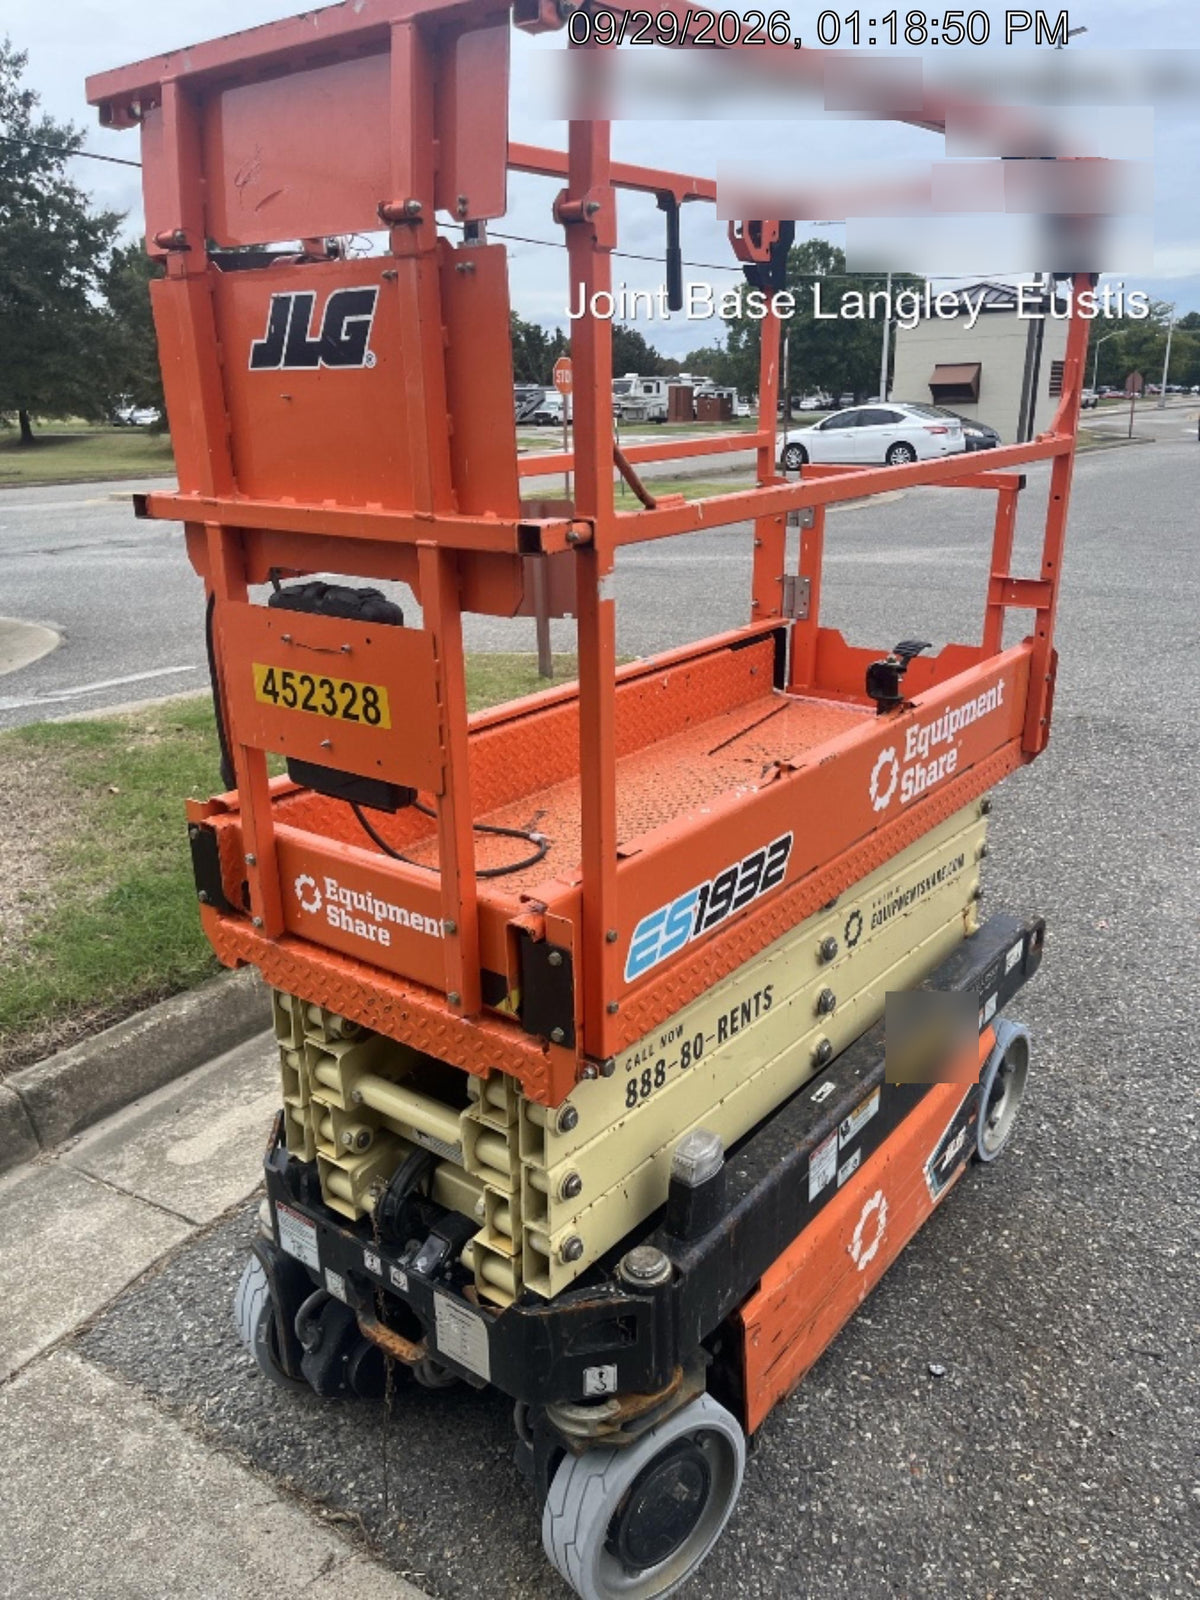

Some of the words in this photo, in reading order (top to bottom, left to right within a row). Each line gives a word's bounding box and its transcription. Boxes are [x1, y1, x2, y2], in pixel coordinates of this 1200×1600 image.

[556, 369, 572, 383] STO
[263, 668, 381, 725] 452328
[903, 679, 1005, 763] Equipment
[900, 748, 958, 804] Share
[326, 904, 391, 946] Share
[625, 984, 774, 1108] 888-80-RENTS
[625, 1044, 655, 1072] CALL
[660, 1024, 684, 1047] NOW
